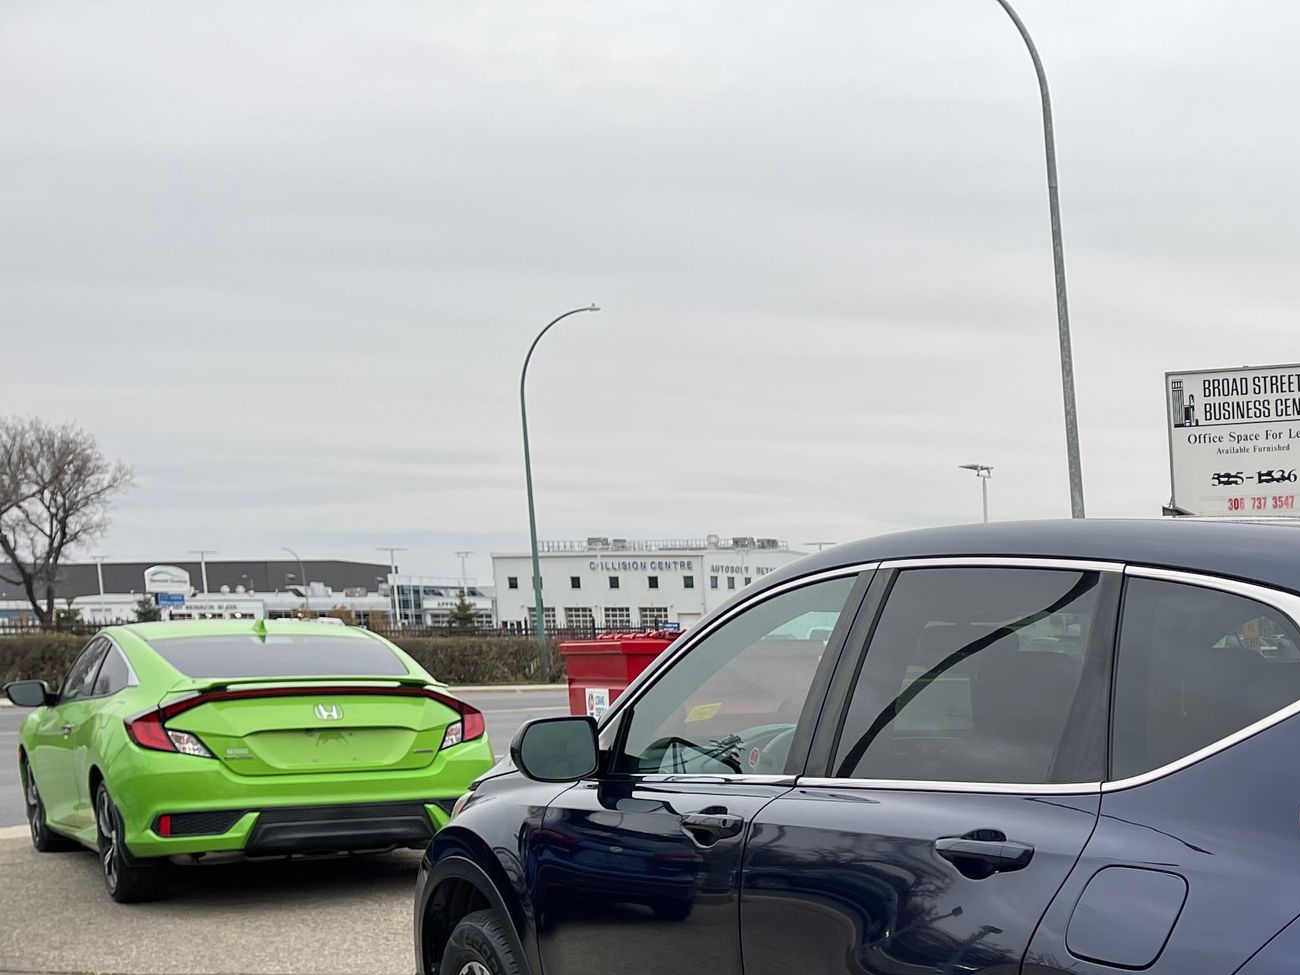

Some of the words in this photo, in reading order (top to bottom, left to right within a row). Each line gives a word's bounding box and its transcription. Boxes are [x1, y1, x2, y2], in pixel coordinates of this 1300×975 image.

[1203, 377, 1249, 397] BROAD
[1204, 399, 1271, 421] BUSINESS
[1187, 432, 1224, 445] Office
[1228, 432, 1260, 444] Space
[1265, 429, 1283, 440] For
[1216, 446, 1250, 455] Available
[1253, 444, 1290, 453] Furnished
[1227, 497, 1245, 511] 306
[1251, 496, 1267, 510] 737
[1272, 495, 1295, 509] 3547
[650, 560, 693, 571] CENTRE
